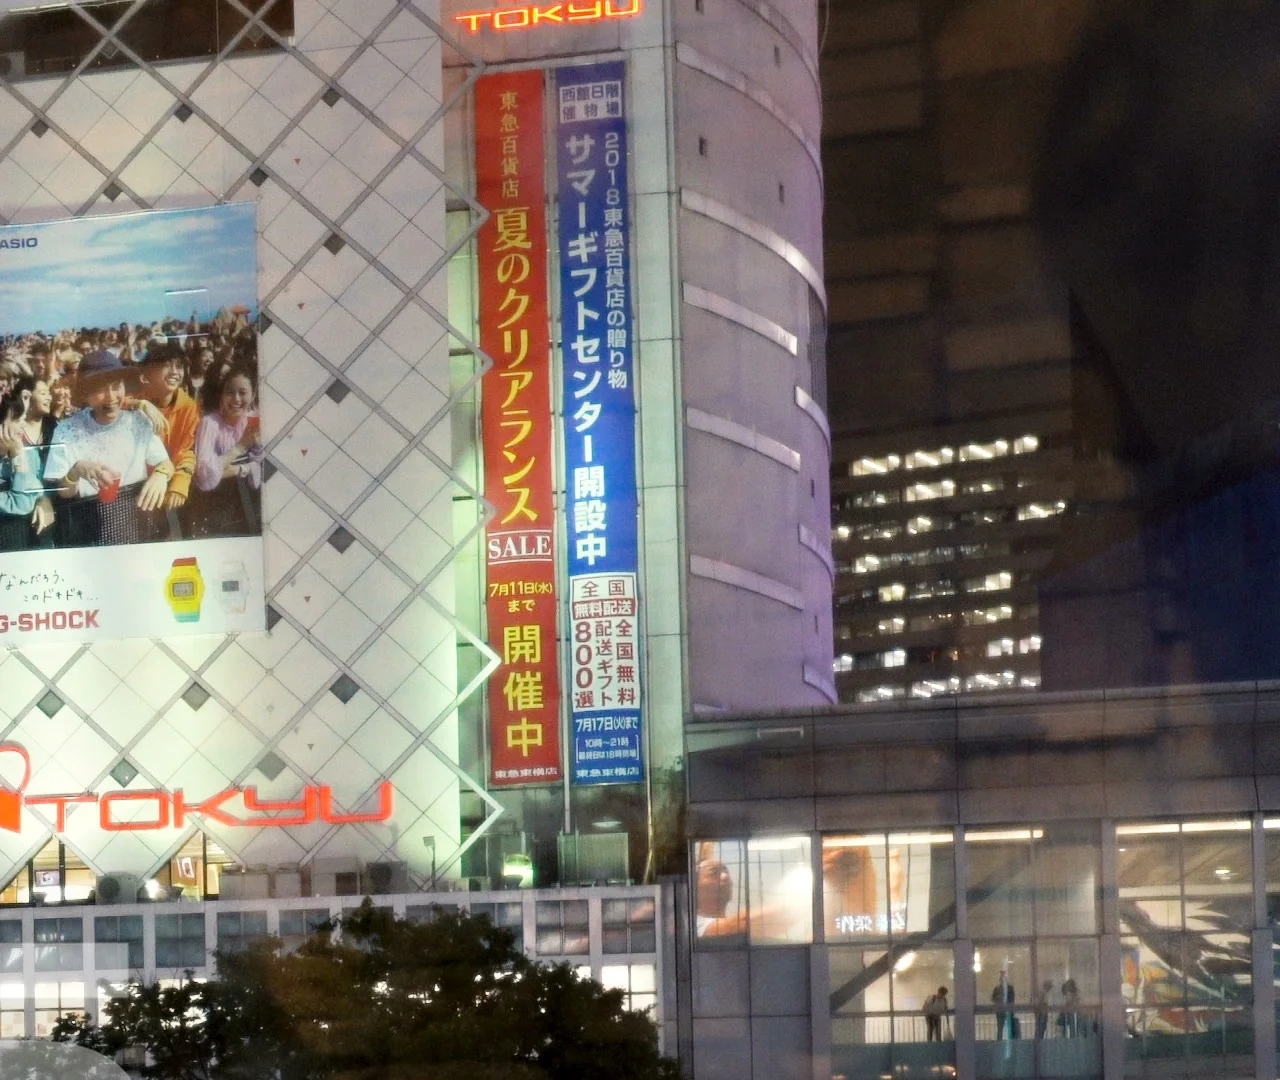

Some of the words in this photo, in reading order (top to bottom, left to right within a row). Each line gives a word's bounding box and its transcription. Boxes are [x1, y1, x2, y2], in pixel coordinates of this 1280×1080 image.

[455, 0, 643, 31] TOKYU
[500, 90, 519, 198] 東急百貨店
[493, 206, 538, 525] 夏のクリアランス
[565, 135, 608, 565] サマーギフトセンター開設中
[488, 535, 552, 560] SALE
[489, 580, 553, 598] 7月11日(水)
[507, 599, 536, 613] まで
[574, 601, 632, 618] 無料配送
[581, 579, 625, 599] 全国
[502, 624, 545, 758] 開催中
[575, 620, 595, 709] 800選
[595, 619, 614, 708] 配送ギフト
[615, 618, 636, 707] 全国無料
[24, 781, 392, 833] TOKYU
